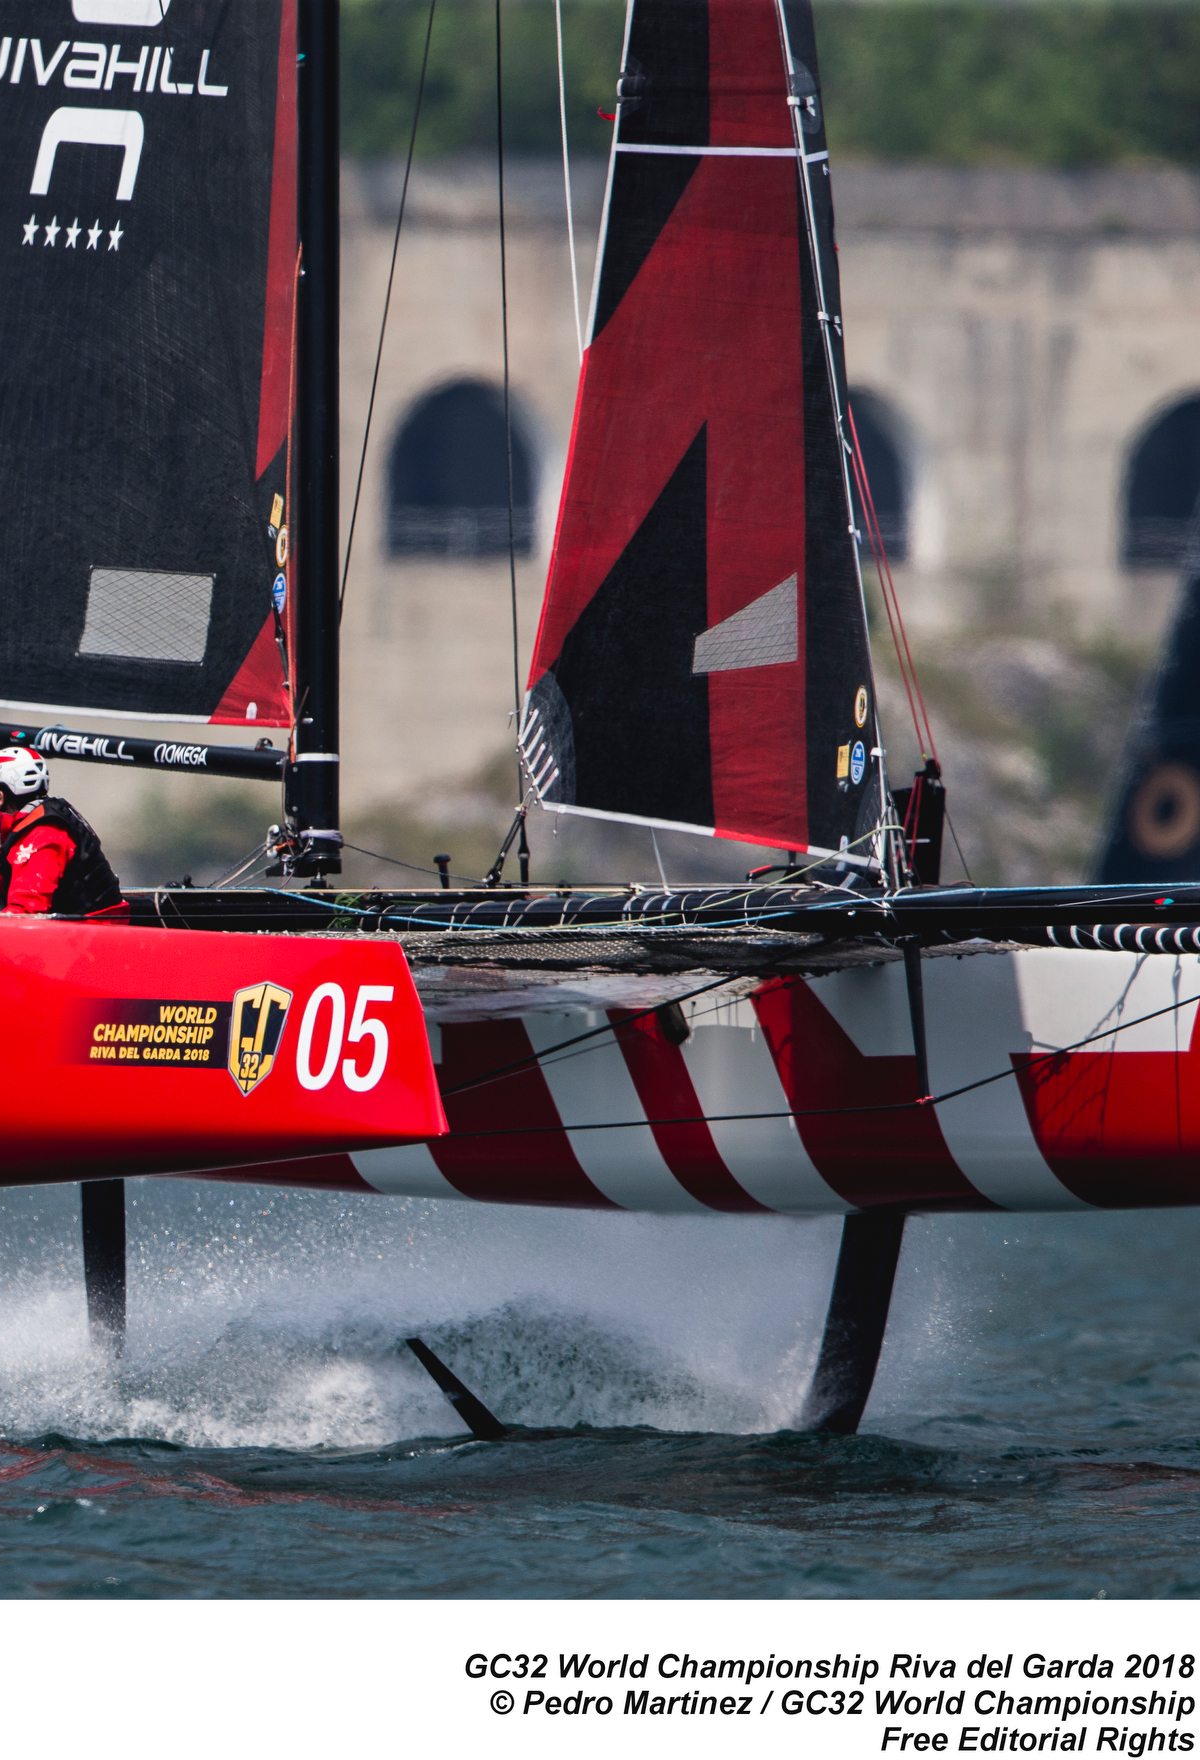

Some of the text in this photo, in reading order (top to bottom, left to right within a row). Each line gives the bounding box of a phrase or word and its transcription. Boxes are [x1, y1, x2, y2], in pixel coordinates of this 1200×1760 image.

[159, 1006, 217, 1024] WORLD
[93, 1023, 214, 1044] CHAMPIONSHIP
[296, 982, 395, 1092] 05
[89, 1046, 210, 1061] RIVA DEL GARDA 2018
[240, 1053, 260, 1079] 32
